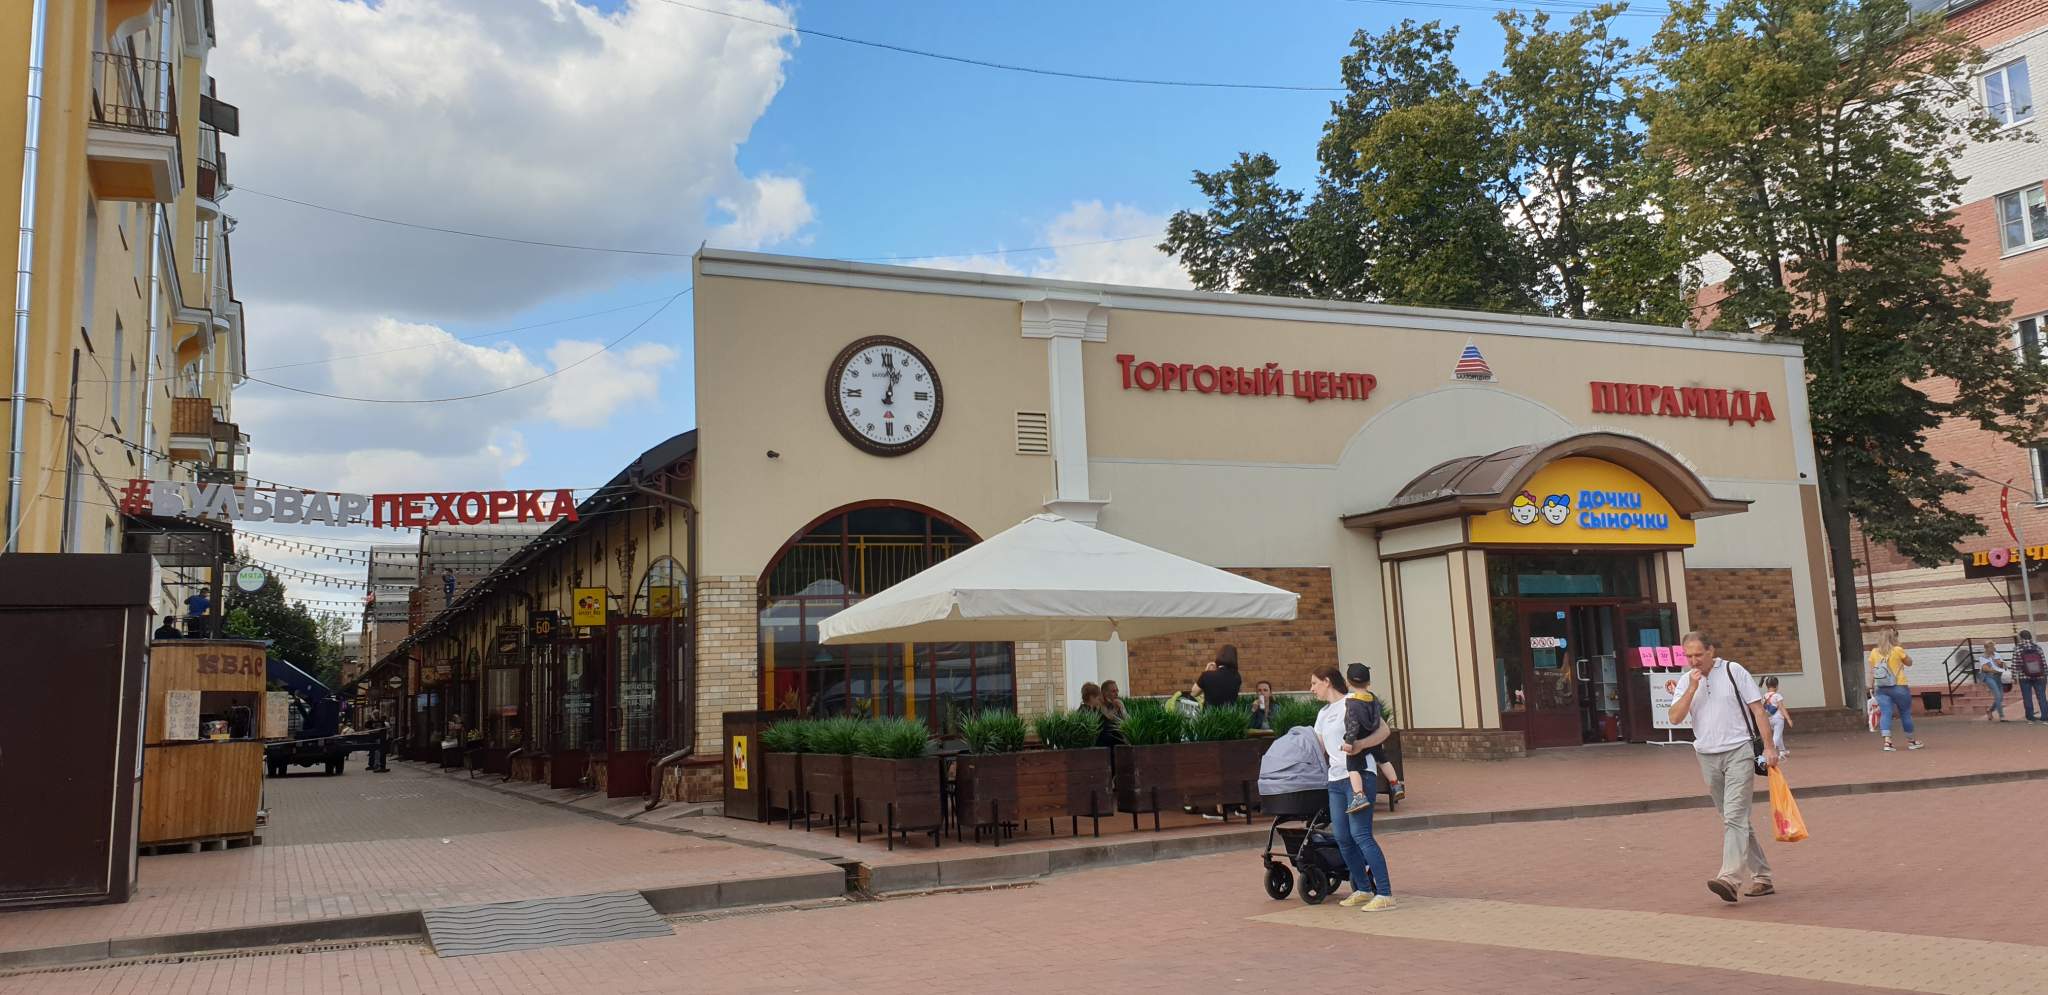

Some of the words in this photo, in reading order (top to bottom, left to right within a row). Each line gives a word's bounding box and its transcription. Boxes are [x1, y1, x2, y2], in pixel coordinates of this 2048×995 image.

[1116, 354, 1284, 397] ТОРГОВЫЙ
[1293, 369, 1377, 403] ЦЕНТР
[1590, 381, 1776, 427] ПИРАМИДА
[196, 654, 263, 677] КВАС
